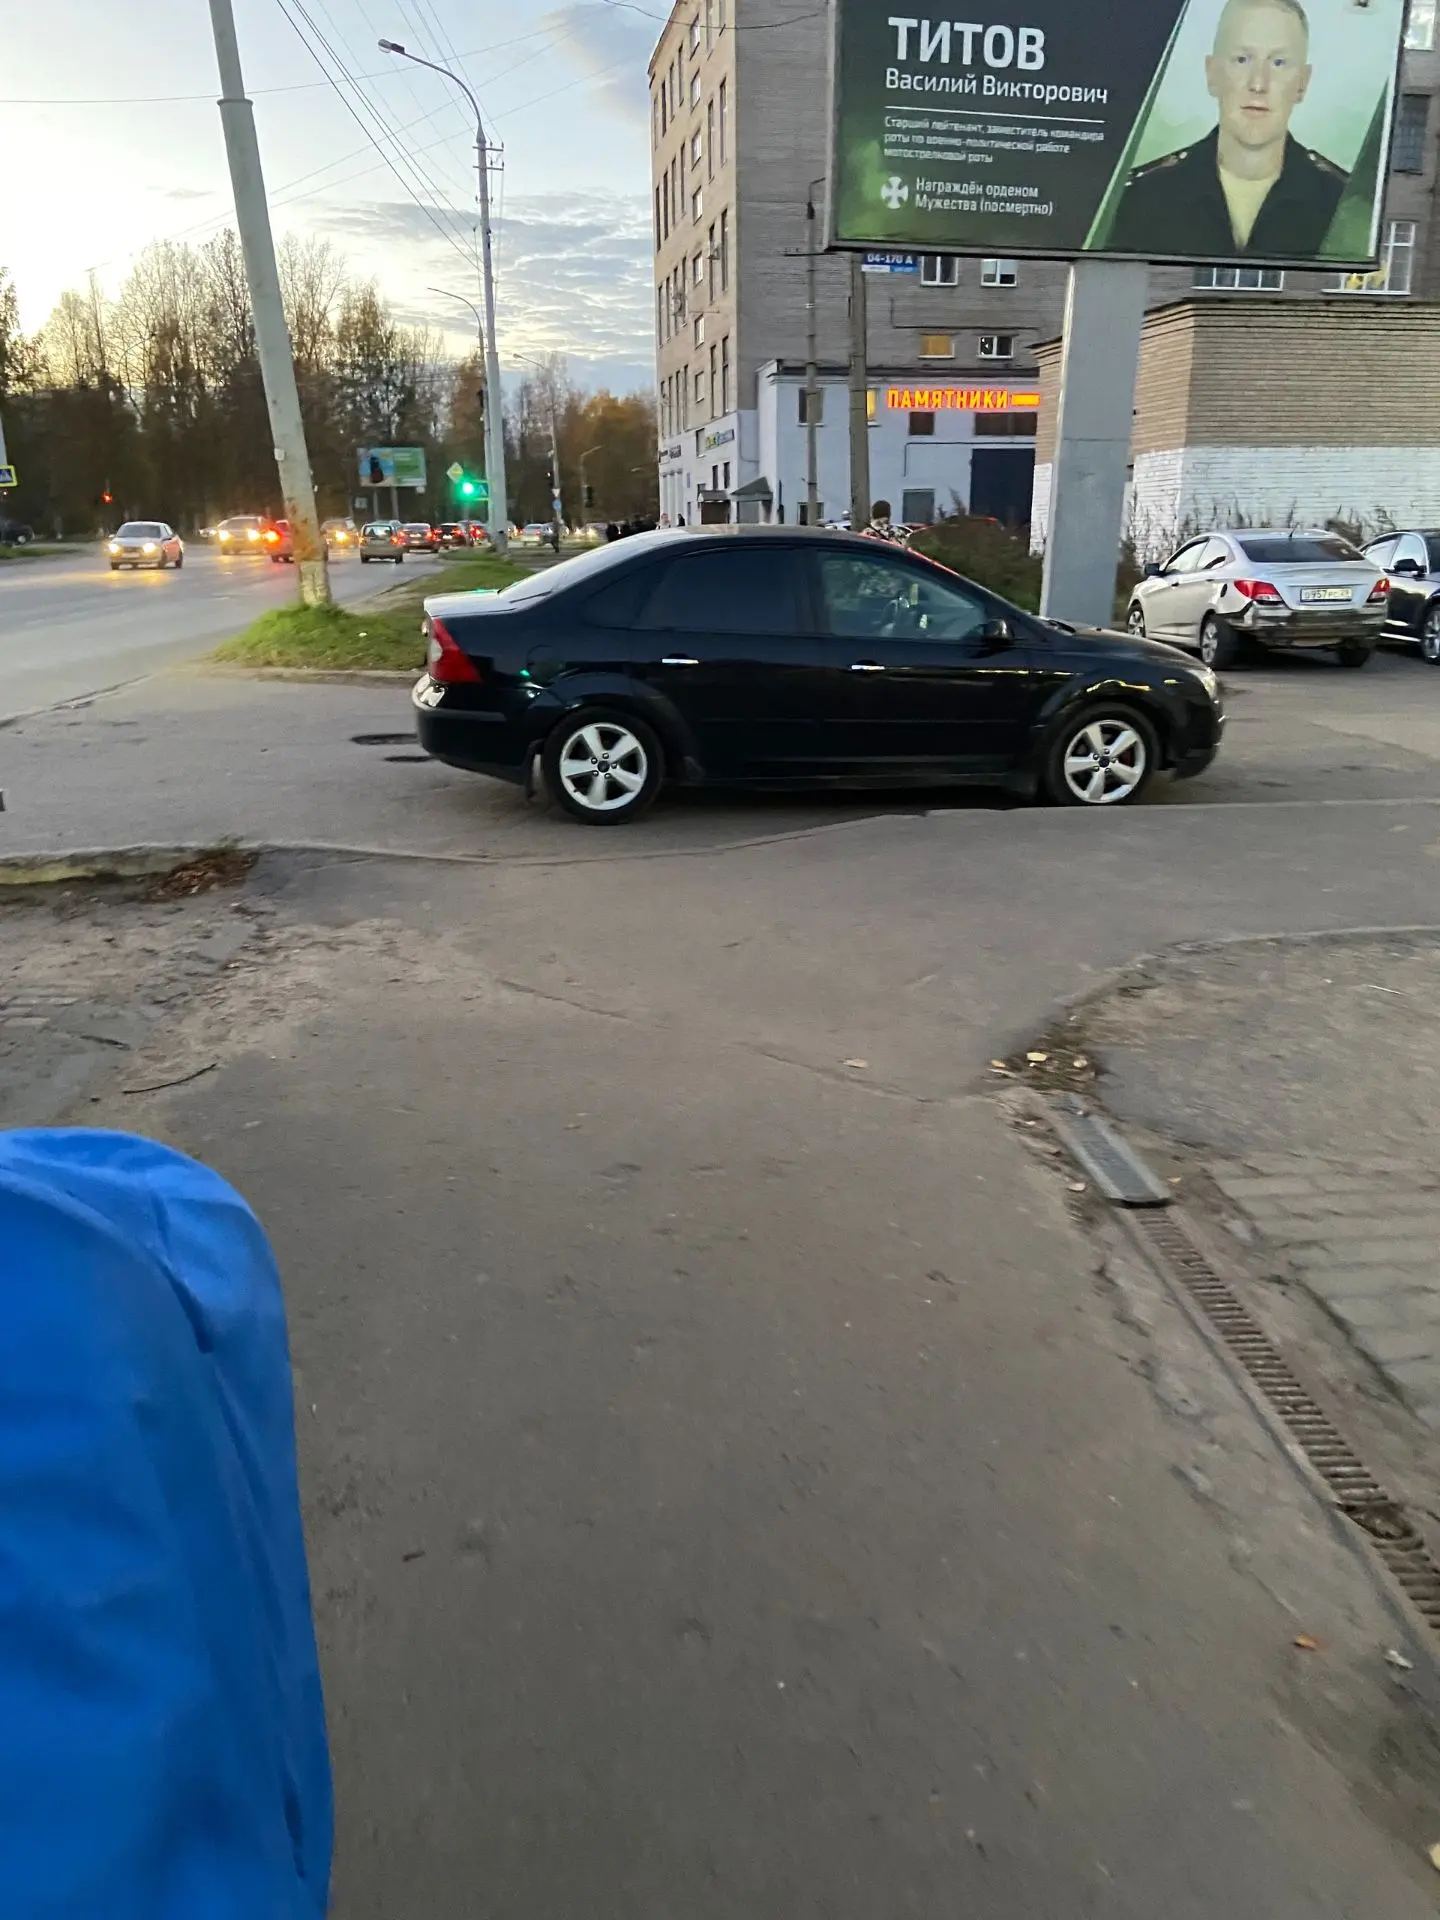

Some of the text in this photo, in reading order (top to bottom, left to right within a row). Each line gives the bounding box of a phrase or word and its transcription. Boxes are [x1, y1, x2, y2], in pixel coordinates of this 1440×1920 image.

[888, 17, 1045, 70] ТИТОВ
[886, 67, 1108, 104] Василий Викторович
[884, 116, 930, 130] Старший
[884, 133, 910, 144] роты
[968, 153, 993, 164] роты
[916, 177, 1039, 198] Награждён орденом
[915, 194, 1053, 216] Мужества (посмертно)
[887, 388, 1008, 409] ПАМЯТНИКИ
